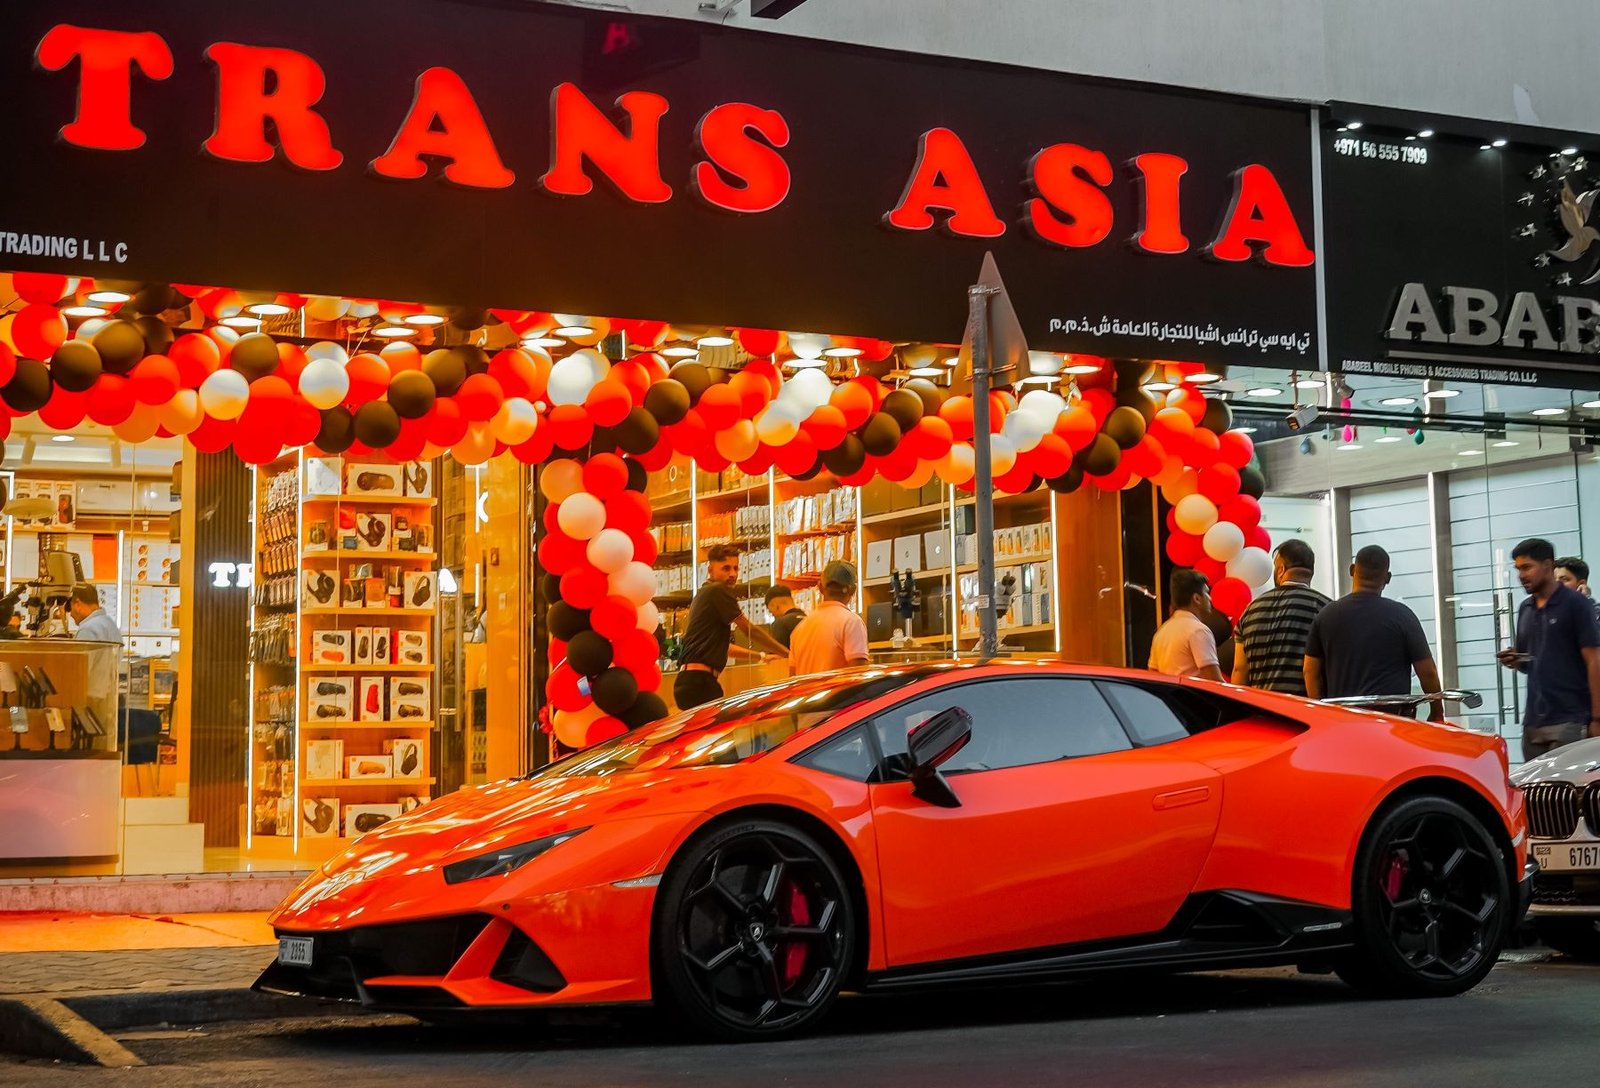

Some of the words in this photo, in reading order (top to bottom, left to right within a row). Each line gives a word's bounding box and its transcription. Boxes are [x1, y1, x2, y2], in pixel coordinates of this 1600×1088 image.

[36, 24, 791, 213] TRANS
[886, 127, 1315, 267] ASIA
[1334, 138, 1360, 156] +971
[1362, 141, 1378, 159] 56
[1378, 143, 1400, 161] 555
[1400, 145, 1428, 165] 7909
[83, 239, 95, 261] L
[99, 240, 111, 262] L
[115, 242, 128, 263] C
[1112, 318, 1150, 337] العامة
[1151, 321, 1193, 343] للتجارة
[1194, 323, 1220, 345] اشيا
[1221, 327, 1258, 347] ترانس
[1259, 334, 1279, 353] سي
[1297, 332, 1310, 354] تي
[1341, 359, 1373, 372] ABABEEL
[1373, 361, 1400, 375] MOBILE
[1400, 363, 1427, 377] PHONES
[1428, 365, 1435, 377] &
[1434, 366, 1480, 380] ACCESSORIES
[1479, 369, 1509, 382] TRADING
